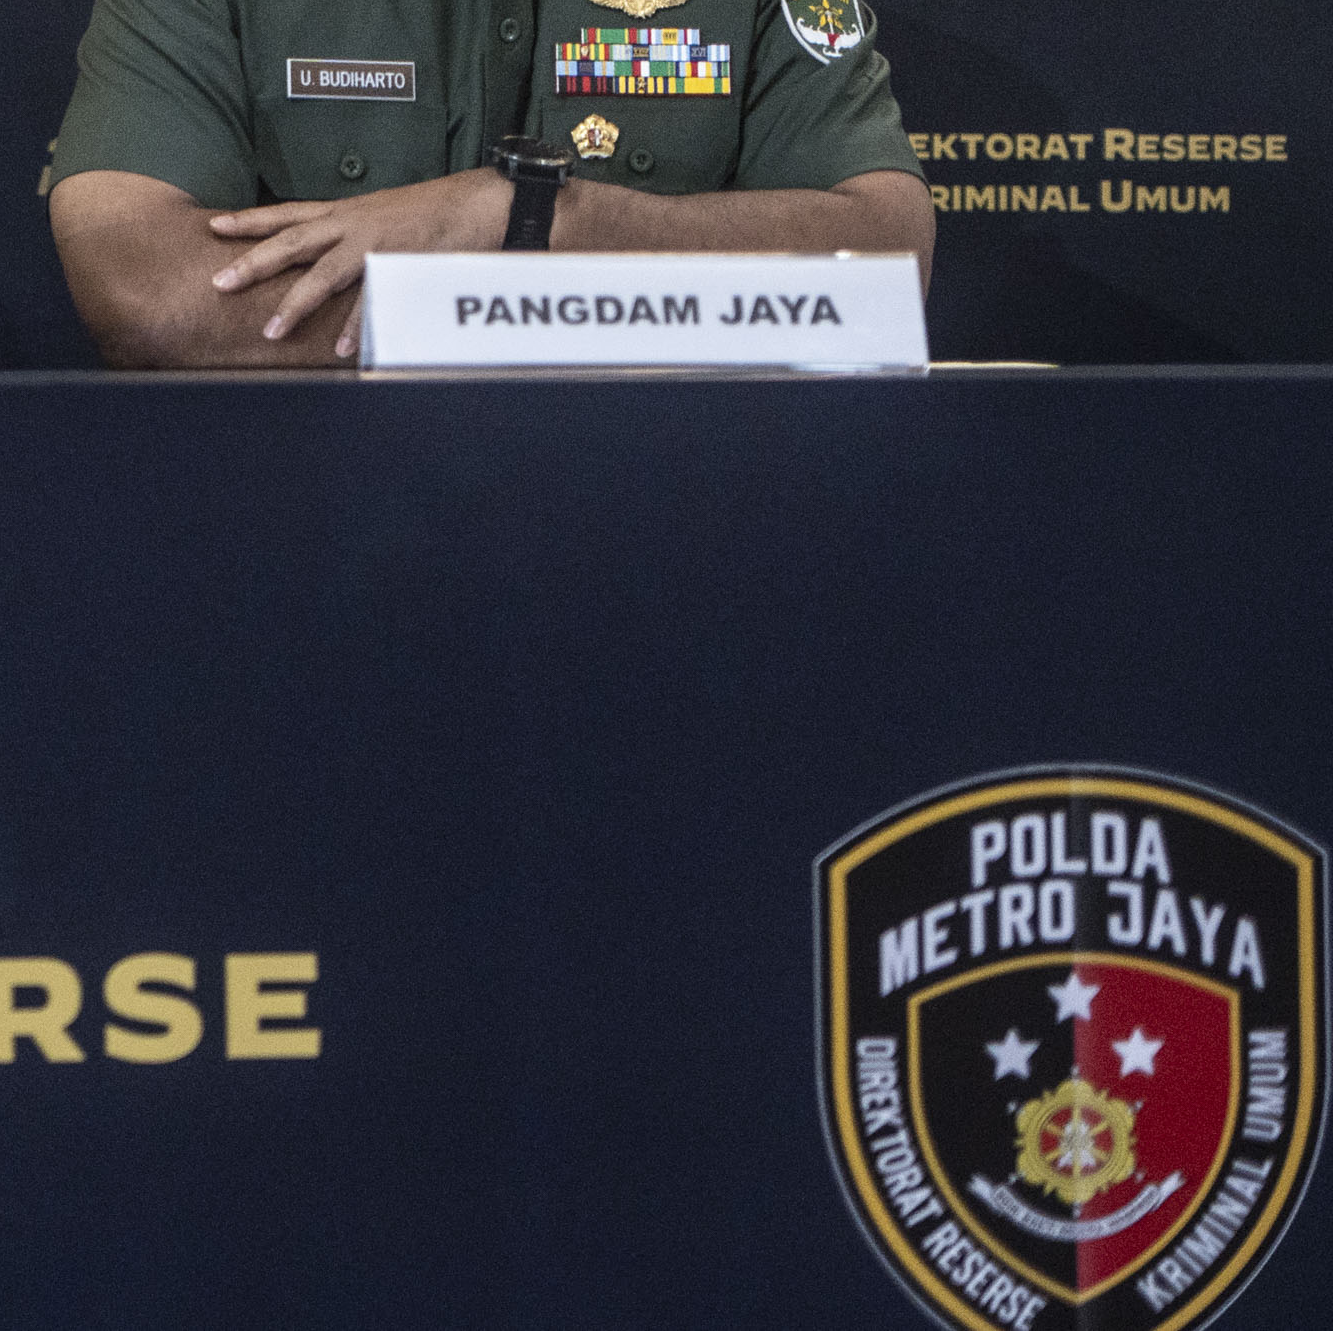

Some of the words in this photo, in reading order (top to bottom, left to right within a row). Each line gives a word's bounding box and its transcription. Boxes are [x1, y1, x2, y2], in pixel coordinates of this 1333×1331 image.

[301, 70, 315, 86] U.
[320, 71, 405, 88] BUDIHARTO
[909, 133, 1093, 160] EKTORAT
[1103, 127, 1288, 162] RESERSE
[933, 185, 1090, 211] RIMINAL
[1100, 179, 1230, 213] UMUM
[455, 295, 701, 326] PANGDAM
[719, 295, 842, 326] JAYA
[970, 812, 1171, 888] POLDA
[879, 879, 1076, 996] METRO
[1106, 881, 1266, 989] JAYA
[856, 1036, 944, 1227] DIREKTORAT
[922, 1221, 1047, 1331] RESERSE
[1136, 1156, 1275, 1314] KRIMINAL
[1243, 1028, 1289, 1143] UMUM
